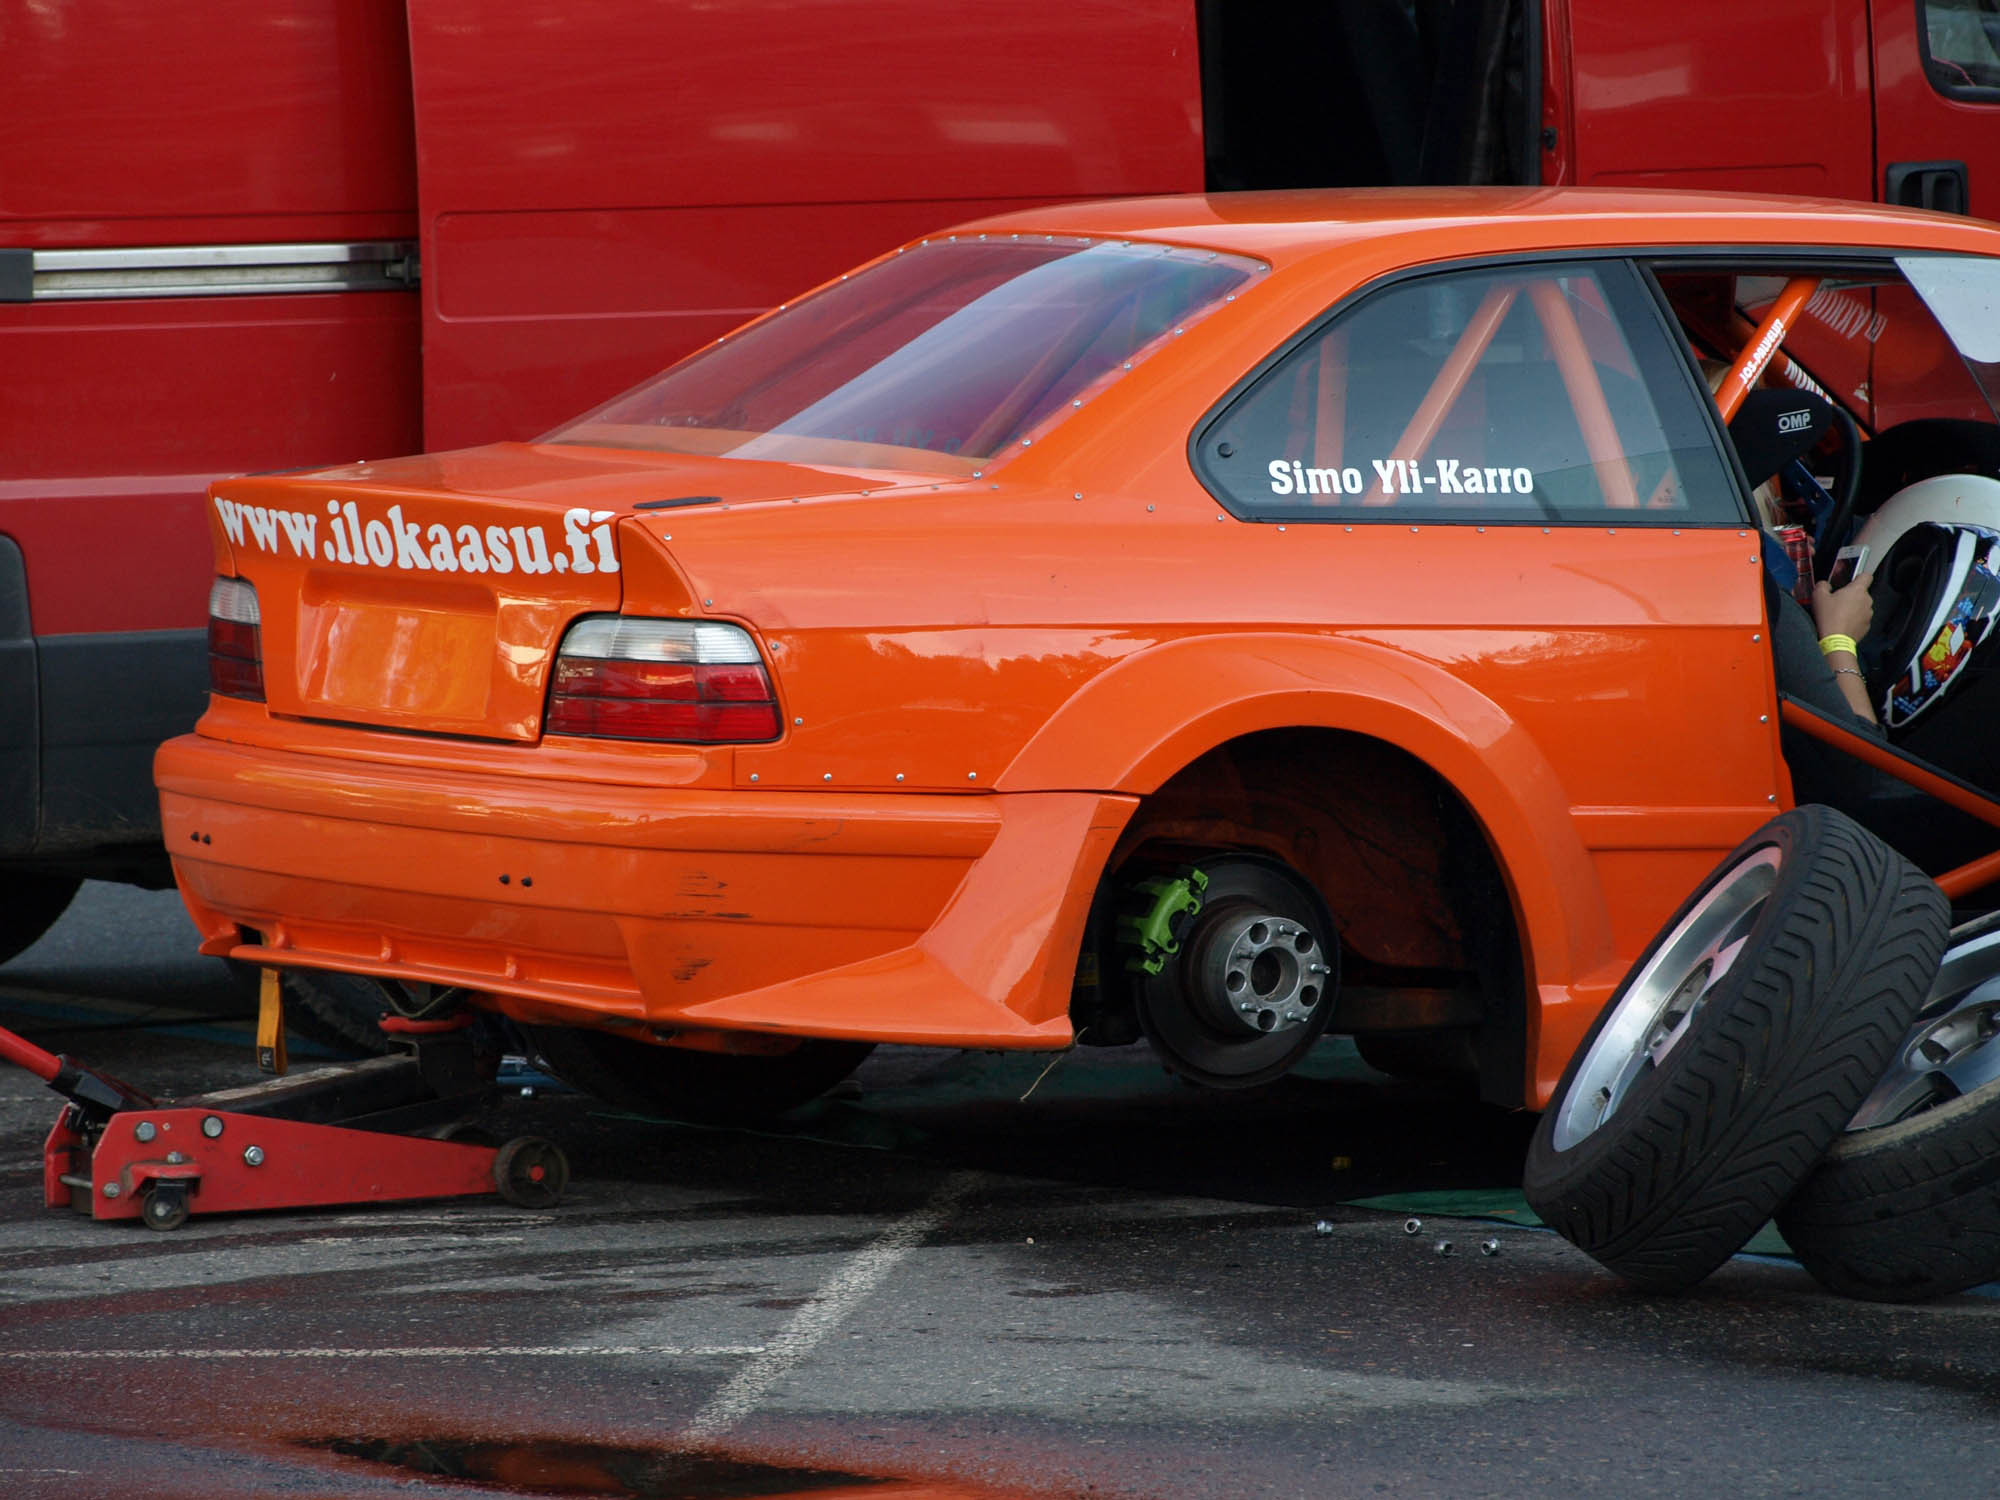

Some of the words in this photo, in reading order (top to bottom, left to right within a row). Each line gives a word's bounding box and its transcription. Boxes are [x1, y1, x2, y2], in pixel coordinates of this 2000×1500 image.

[1778, 412, 1811, 429] OMP
[1268, 459, 1363, 495] Simo
[1372, 459, 1534, 495] Yli-Karro
[214, 497, 620, 575] www.ilokaasu.fi
